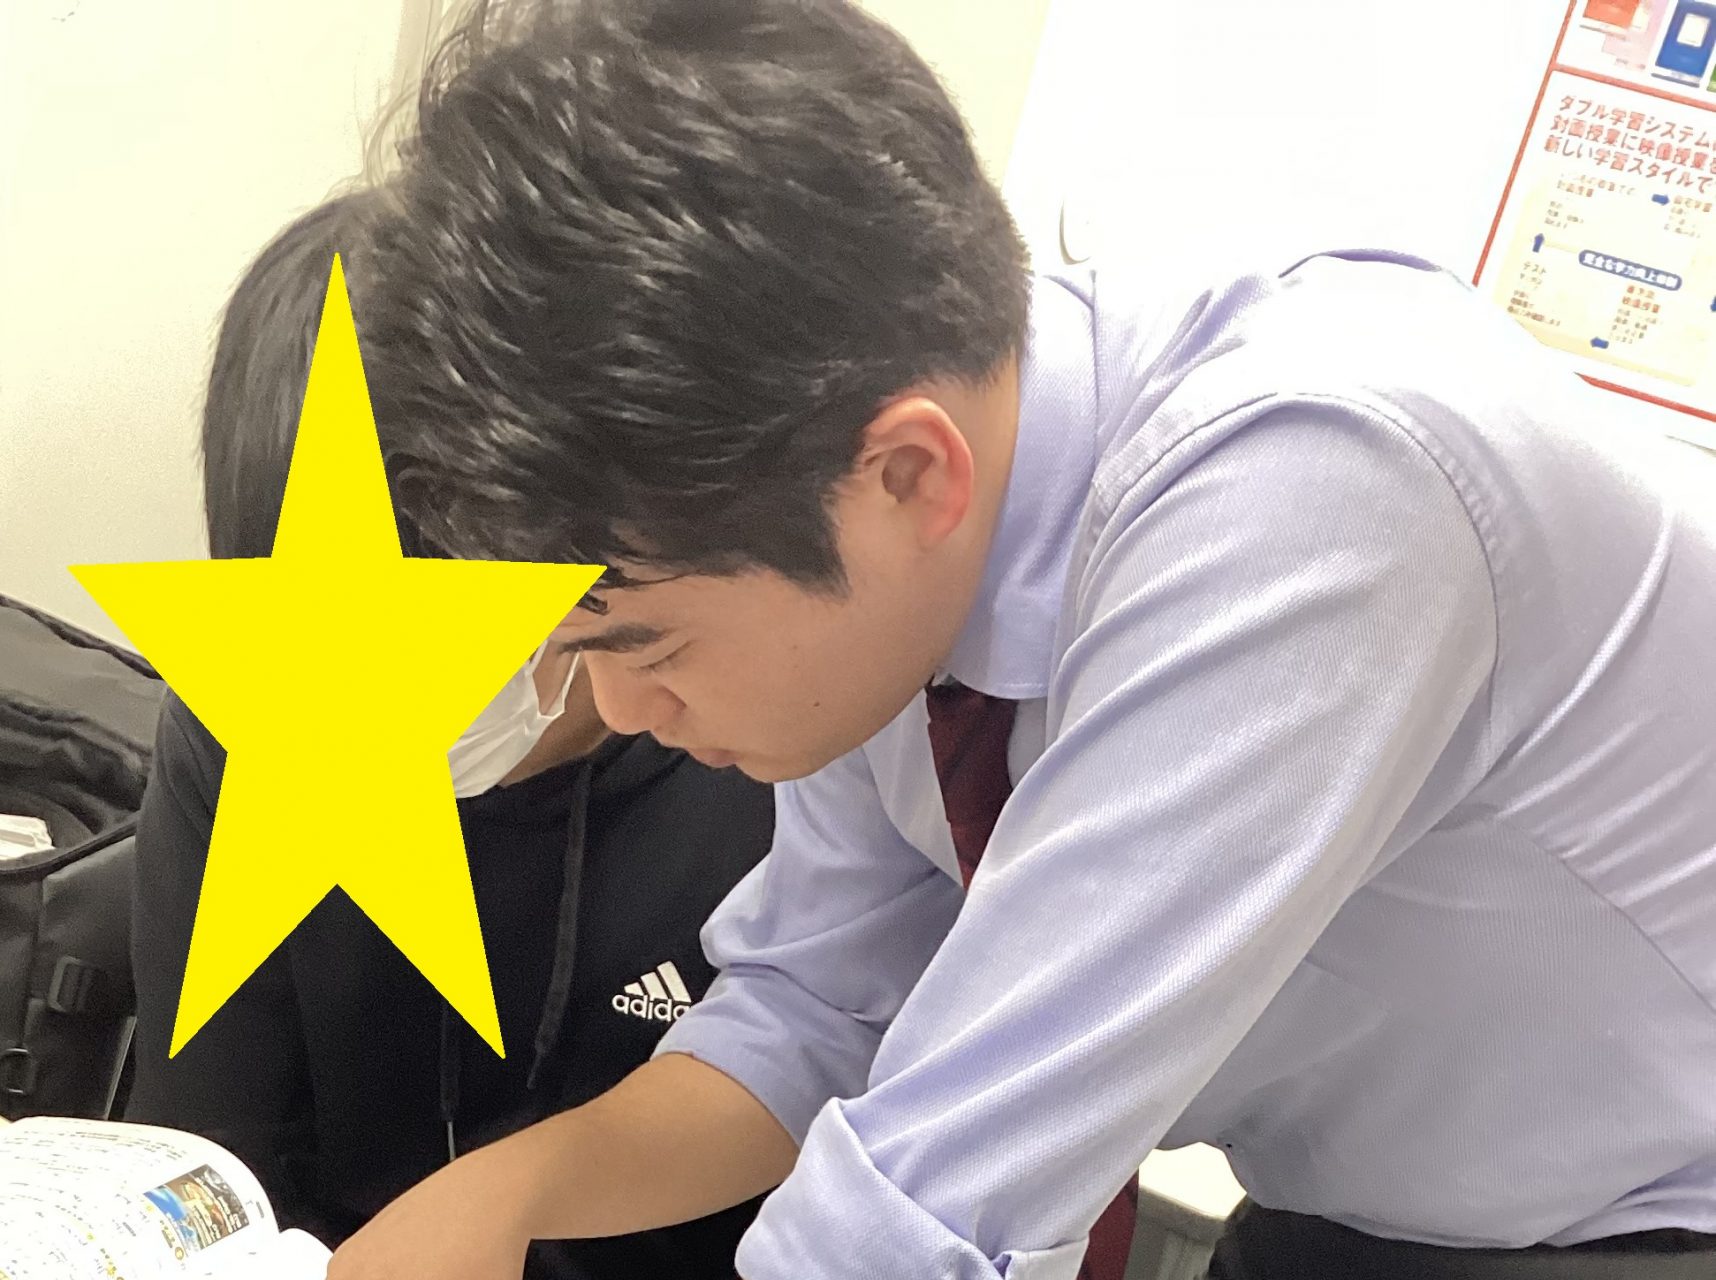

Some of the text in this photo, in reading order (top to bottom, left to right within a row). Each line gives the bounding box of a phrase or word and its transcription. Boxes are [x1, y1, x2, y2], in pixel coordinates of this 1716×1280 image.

[1559, 94, 1716, 152] ダブル学習システム
[611, 994, 692, 1022] adida
